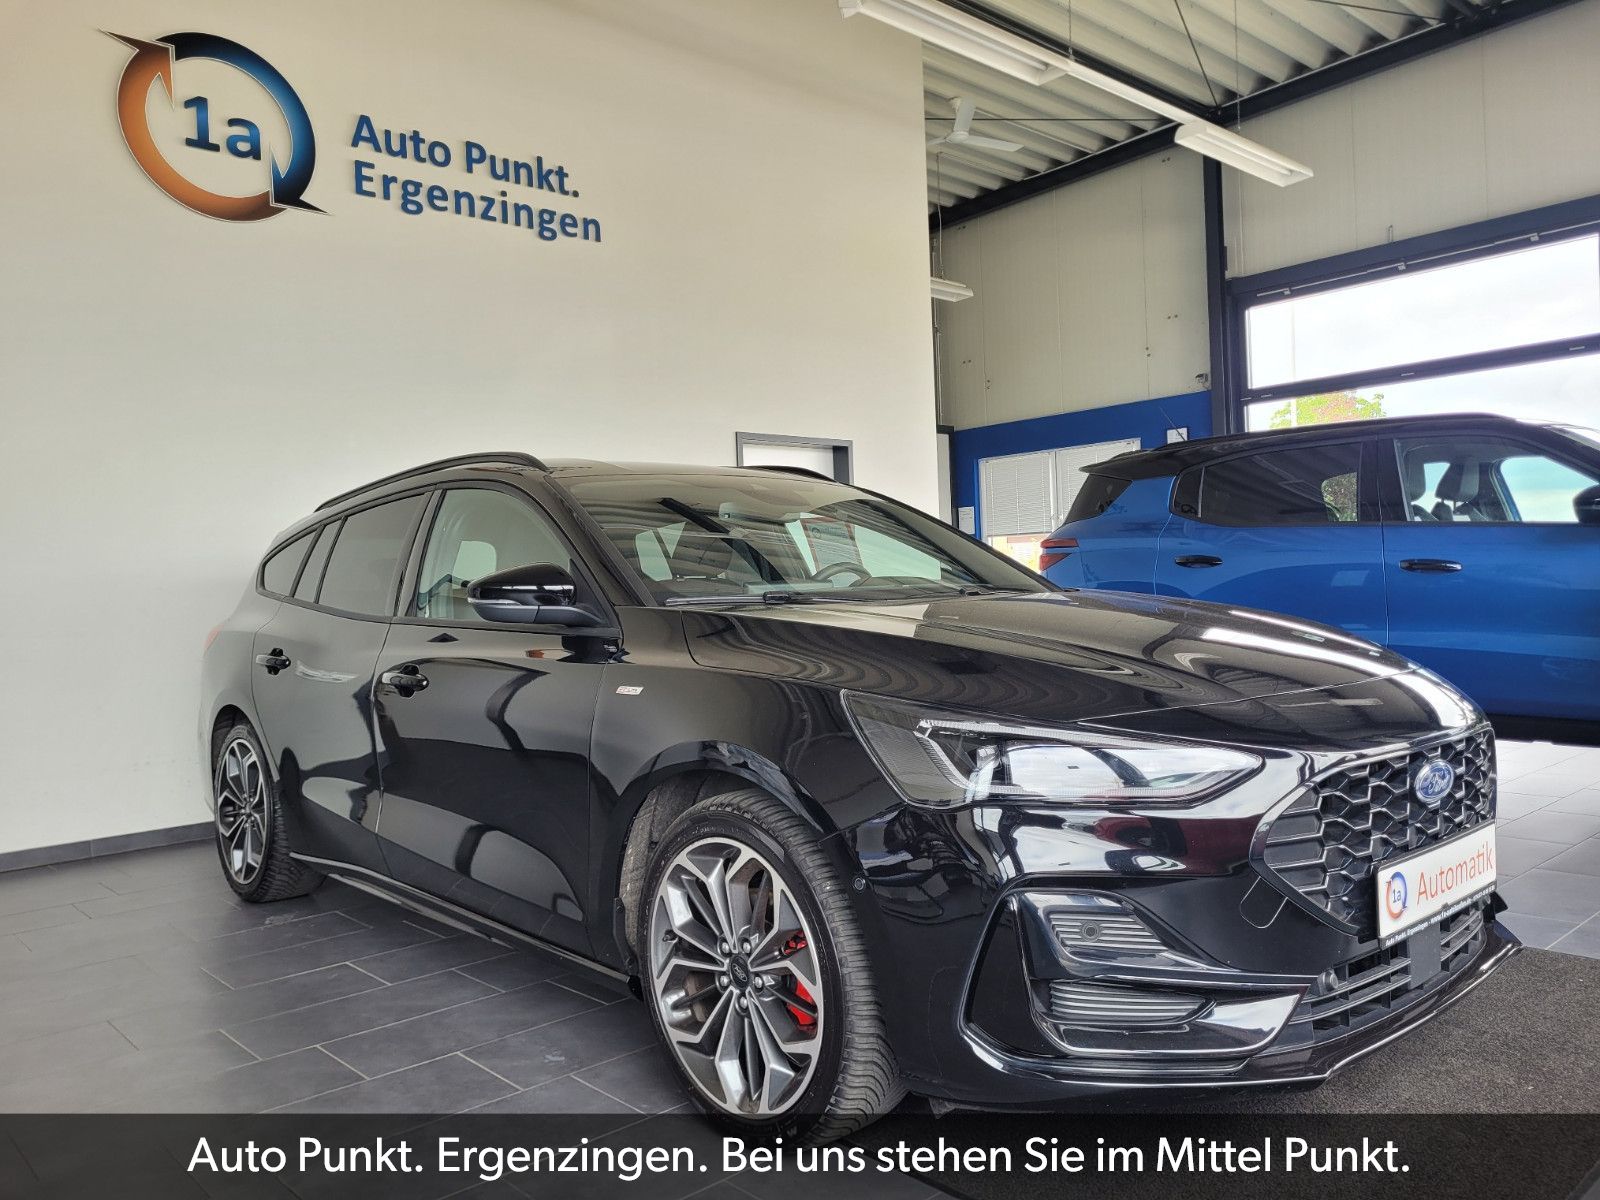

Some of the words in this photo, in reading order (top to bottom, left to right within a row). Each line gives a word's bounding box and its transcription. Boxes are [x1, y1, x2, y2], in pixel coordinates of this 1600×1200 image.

[184, 95, 262, 161] 1a
[351, 114, 452, 168] Auto
[465, 140, 580, 198] Punkt.
[354, 159, 602, 243] Ergenzingen
[1392, 888, 1402, 904] 1a
[1416, 841, 1493, 906] Automatik
